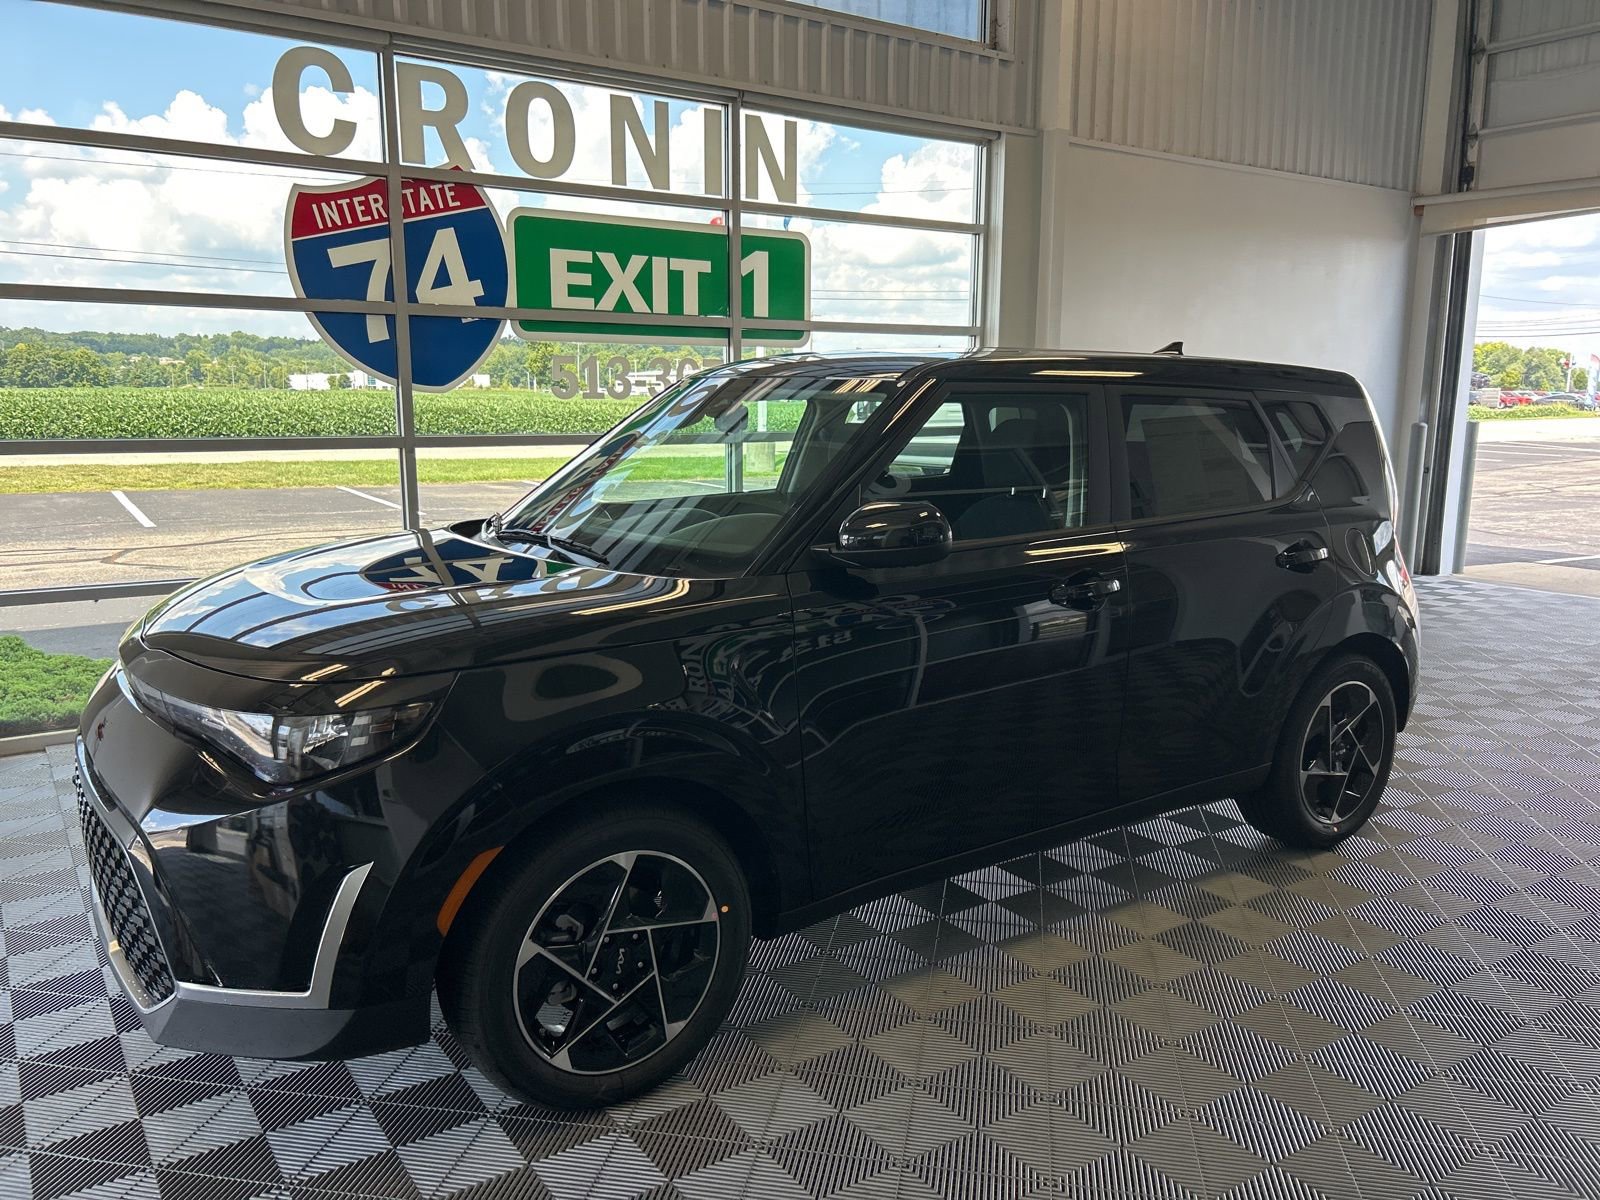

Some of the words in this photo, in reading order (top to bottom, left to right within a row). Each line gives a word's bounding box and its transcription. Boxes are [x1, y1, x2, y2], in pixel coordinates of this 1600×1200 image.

[272, 46, 798, 204] CRONIN
[312, 183, 461, 230] INTERTATE
[327, 227, 485, 344] 74
[549, 247, 712, 316] EXIT
[741, 250, 770, 318] 1
